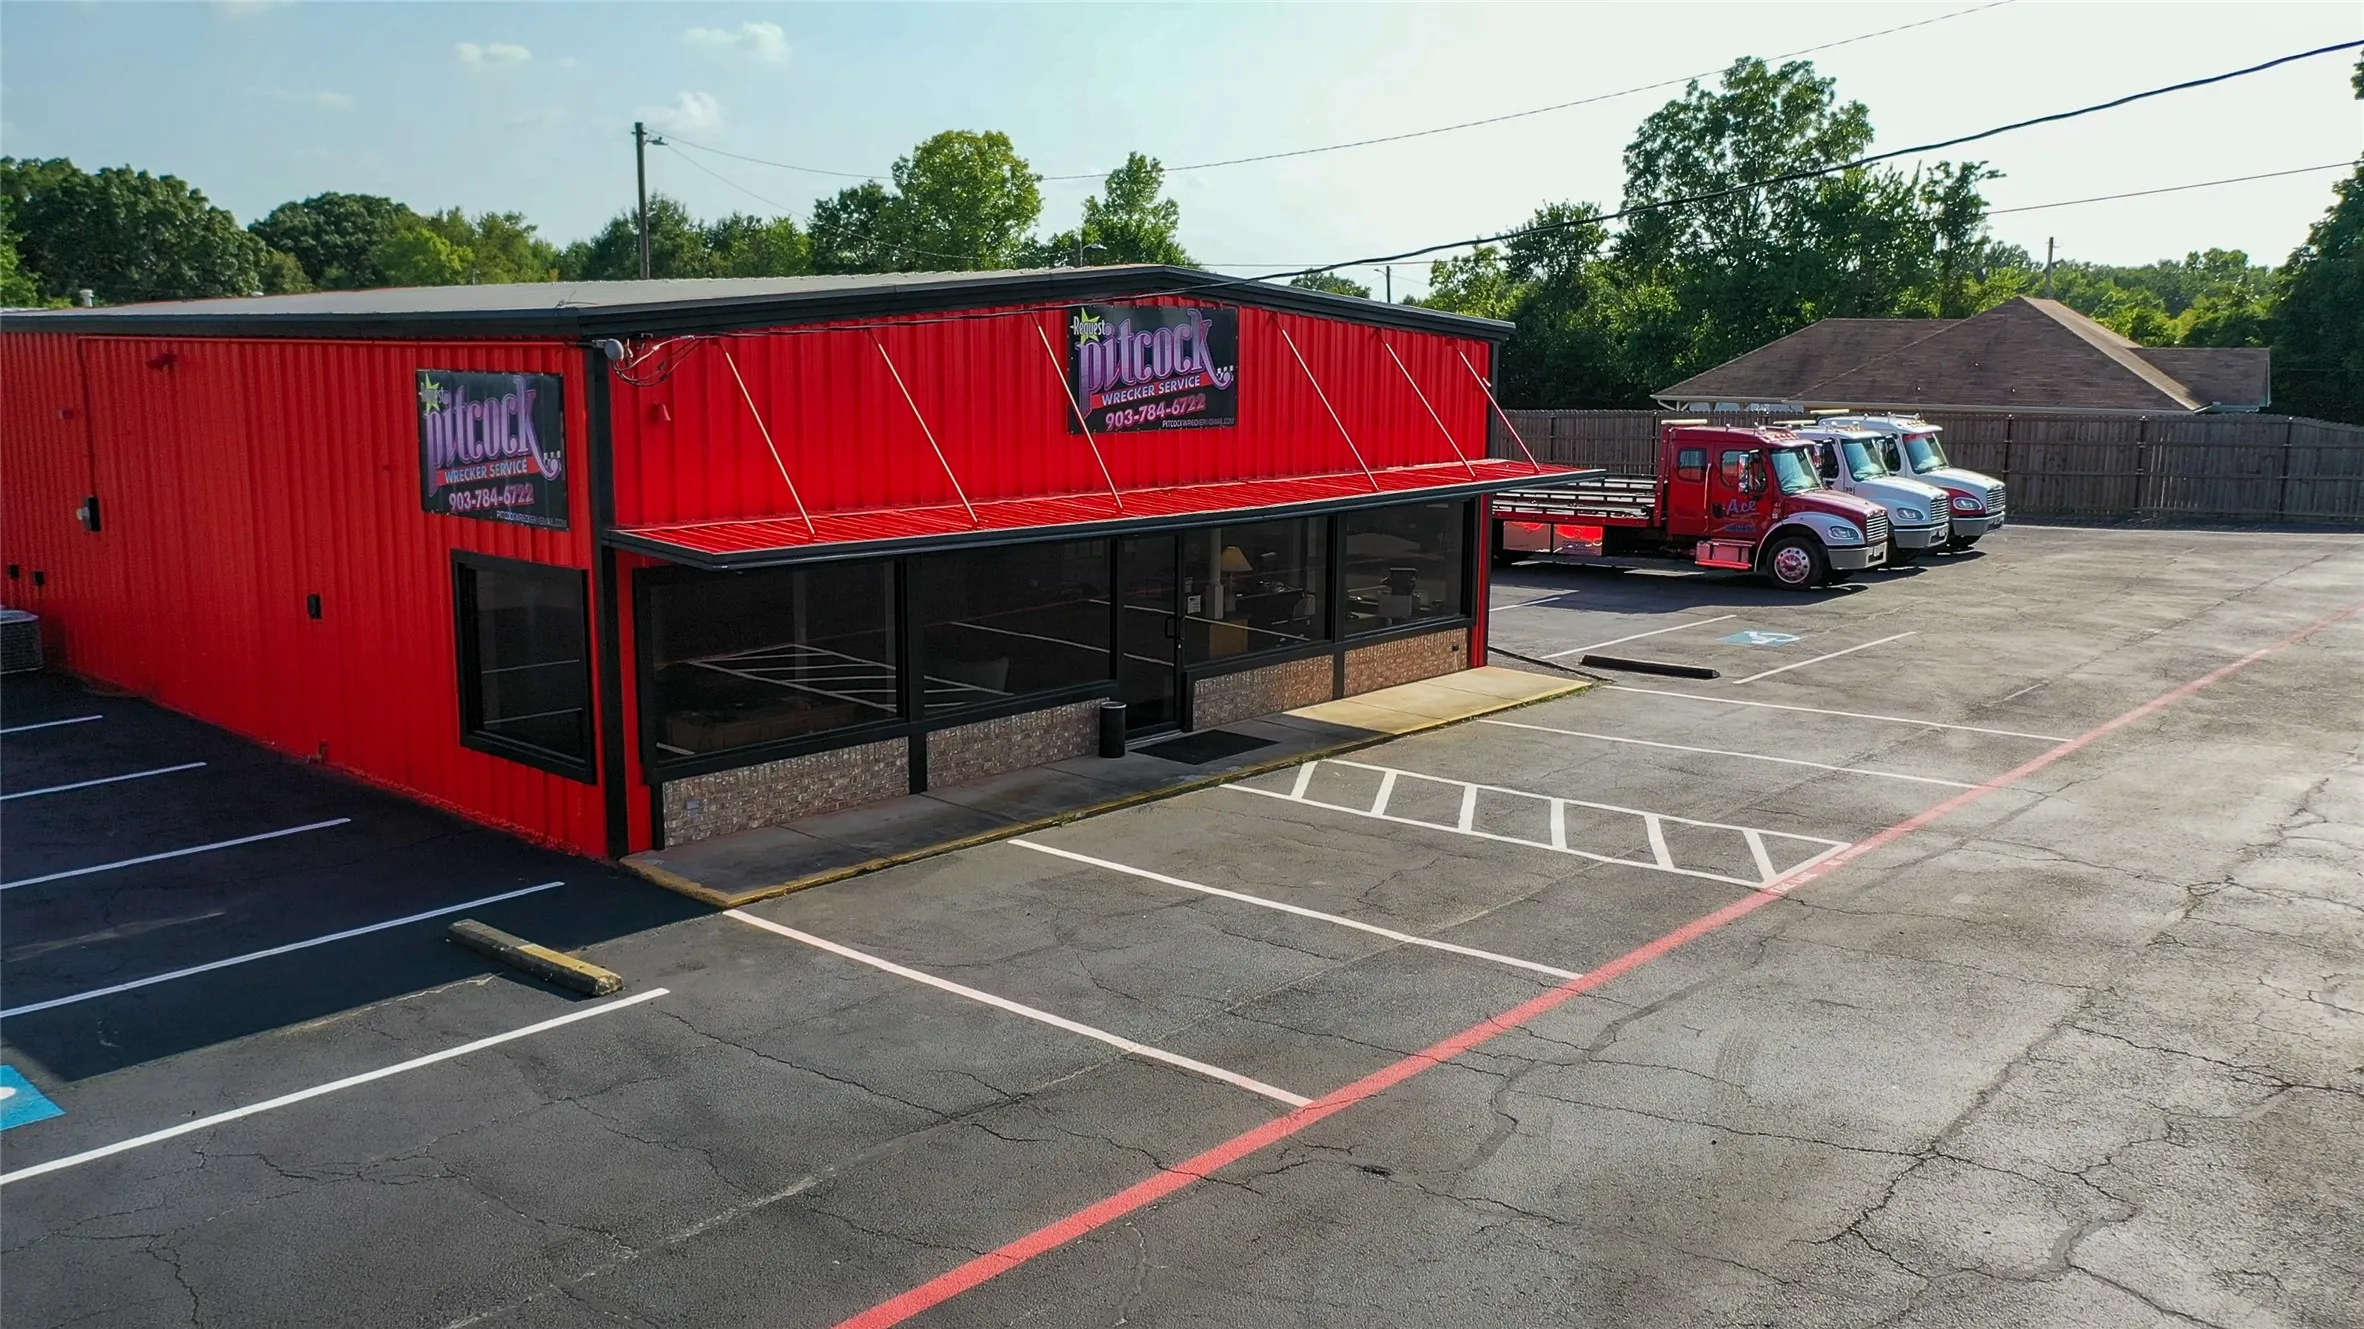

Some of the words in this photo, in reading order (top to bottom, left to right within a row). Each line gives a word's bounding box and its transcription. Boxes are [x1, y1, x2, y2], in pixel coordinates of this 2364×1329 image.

[1073, 315, 1105, 337] Request
[1075, 308, 1232, 420] pitcock
[1102, 385, 1155, 406] WRECKER
[1158, 375, 1201, 395] SERVICE
[1105, 394, 1206, 430] 903-784-6722
[424, 375, 562, 497] pitcock
[444, 466, 488, 484] WRECKER
[489, 459, 528, 477] SERVICE
[449, 484, 535, 512] 903-784-6722
[1726, 498, 1757, 515] Ace
